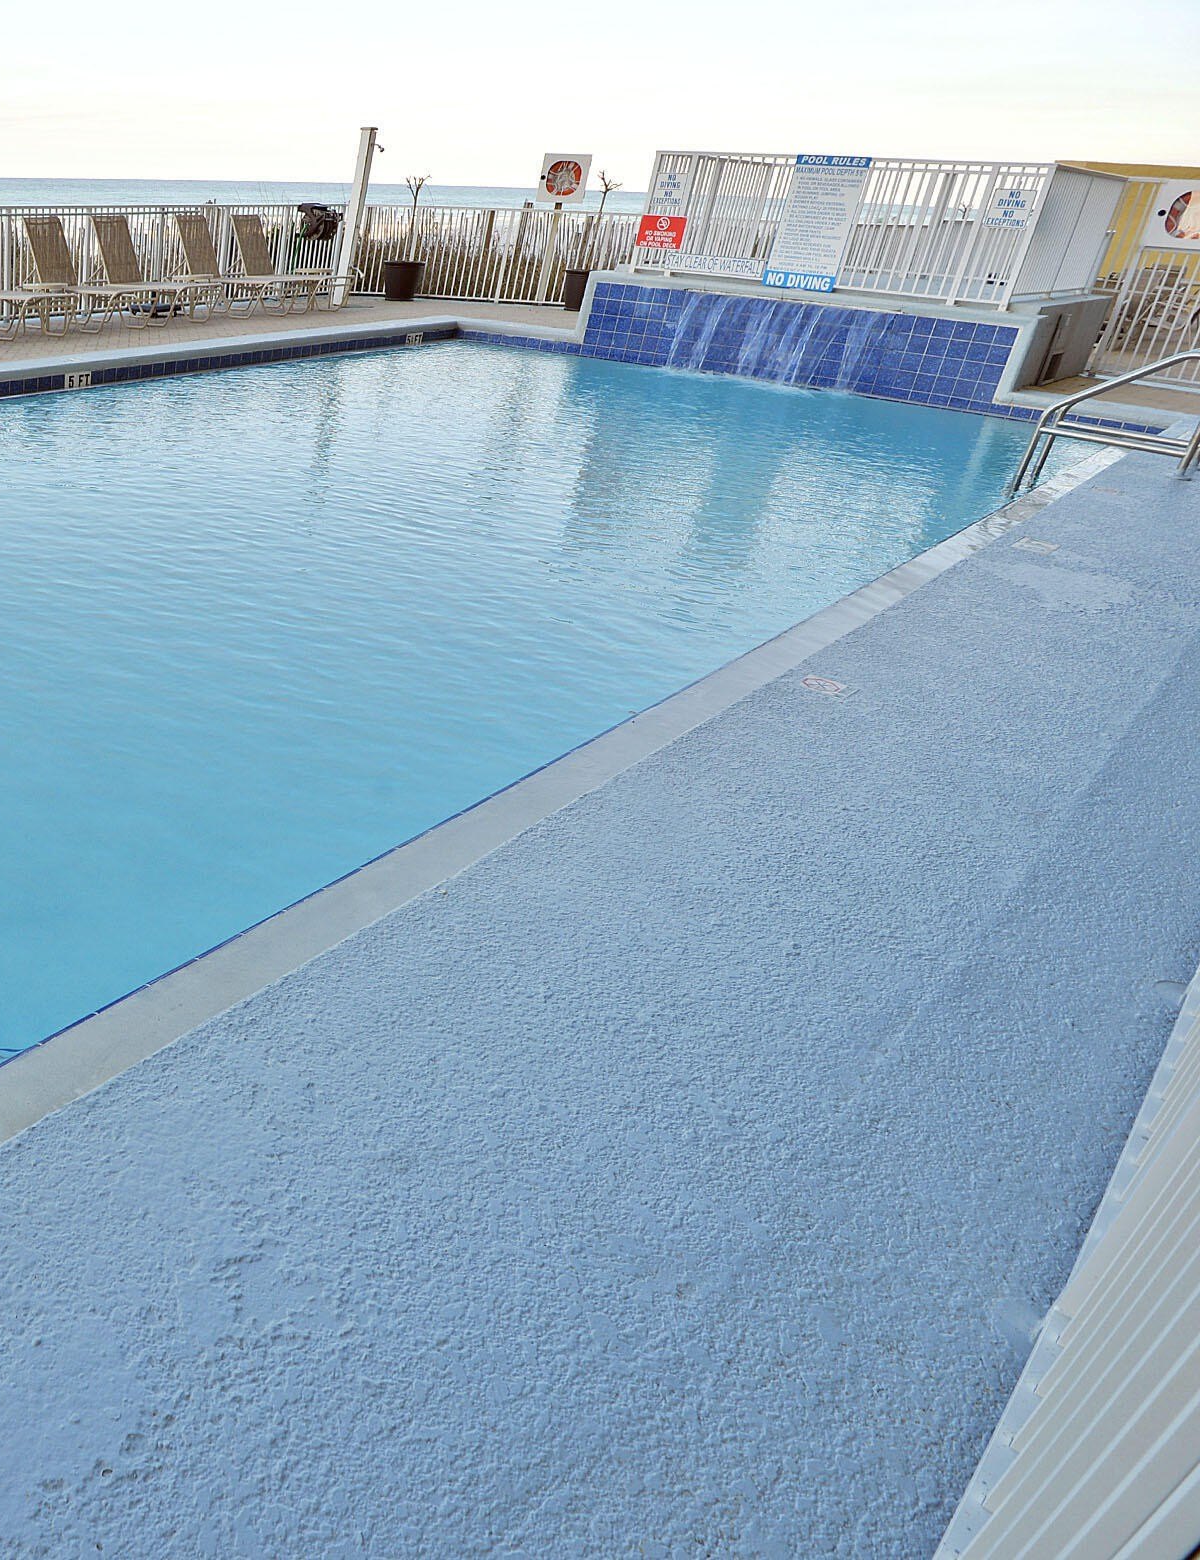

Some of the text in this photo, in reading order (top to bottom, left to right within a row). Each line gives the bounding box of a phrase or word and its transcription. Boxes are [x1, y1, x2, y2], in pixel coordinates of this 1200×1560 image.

[801, 155, 867, 167] POOL RULES
[820, 167, 837, 176] POOL
[837, 168, 855, 176] DEPTH
[660, 181, 681, 189] DIVING
[663, 190, 673, 198] NO
[1009, 190, 1021, 199] NO
[653, 197, 682, 205] EXCEPTIONS
[997, 198, 1027, 208] DIVING
[1002, 209, 1015, 218] NO
[986, 217, 1025, 227] EXCEPTIONS
[653, 230, 677, 238] SMOKING
[666, 254, 684, 267] STAY
[684, 255, 708, 270] CLEAR
[707, 257, 719, 272] OF
[719, 258, 762, 275] WATERFALL
[766, 272, 832, 291] NO DIVING
[68, 375, 75, 388] 5
